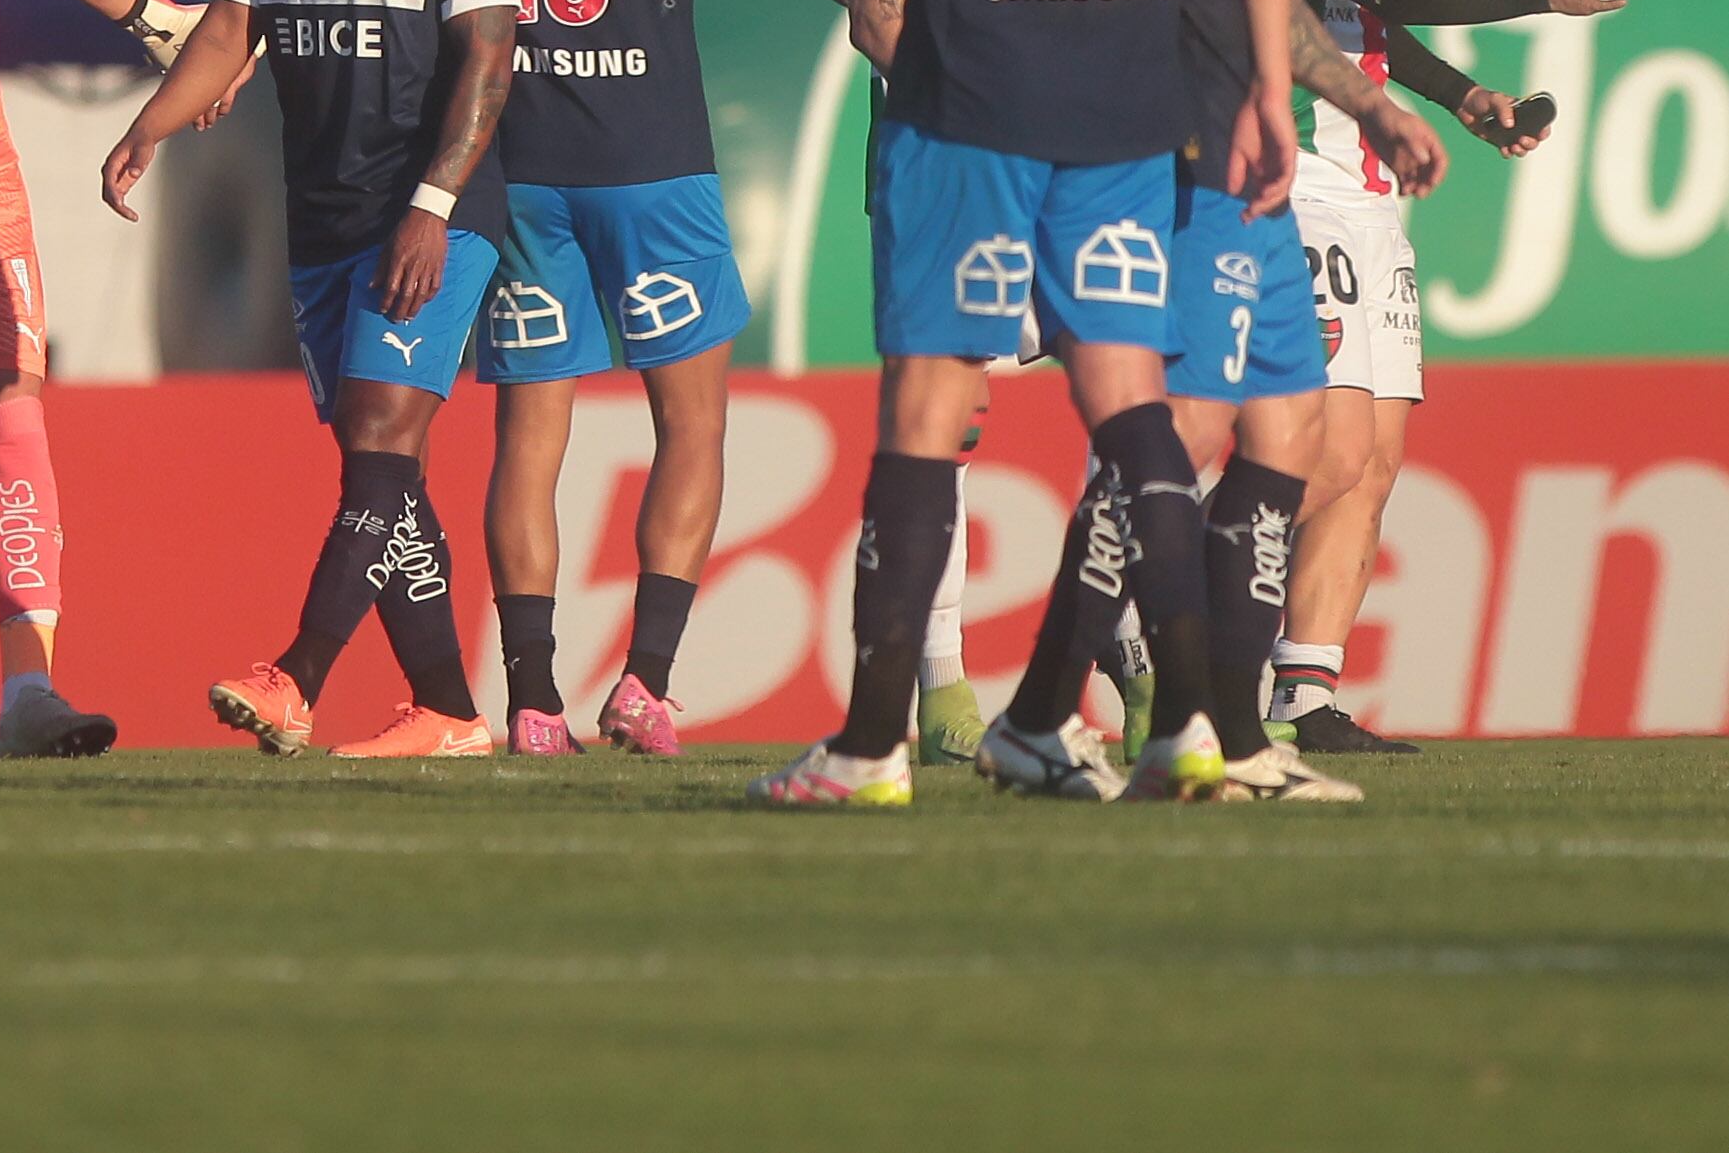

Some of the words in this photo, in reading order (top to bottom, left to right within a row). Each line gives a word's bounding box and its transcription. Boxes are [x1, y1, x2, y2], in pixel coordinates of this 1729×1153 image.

[296, 18, 383, 58] BICE
[513, 45, 647, 77] AMSUNG
[1223, 305, 1251, 384] 3
